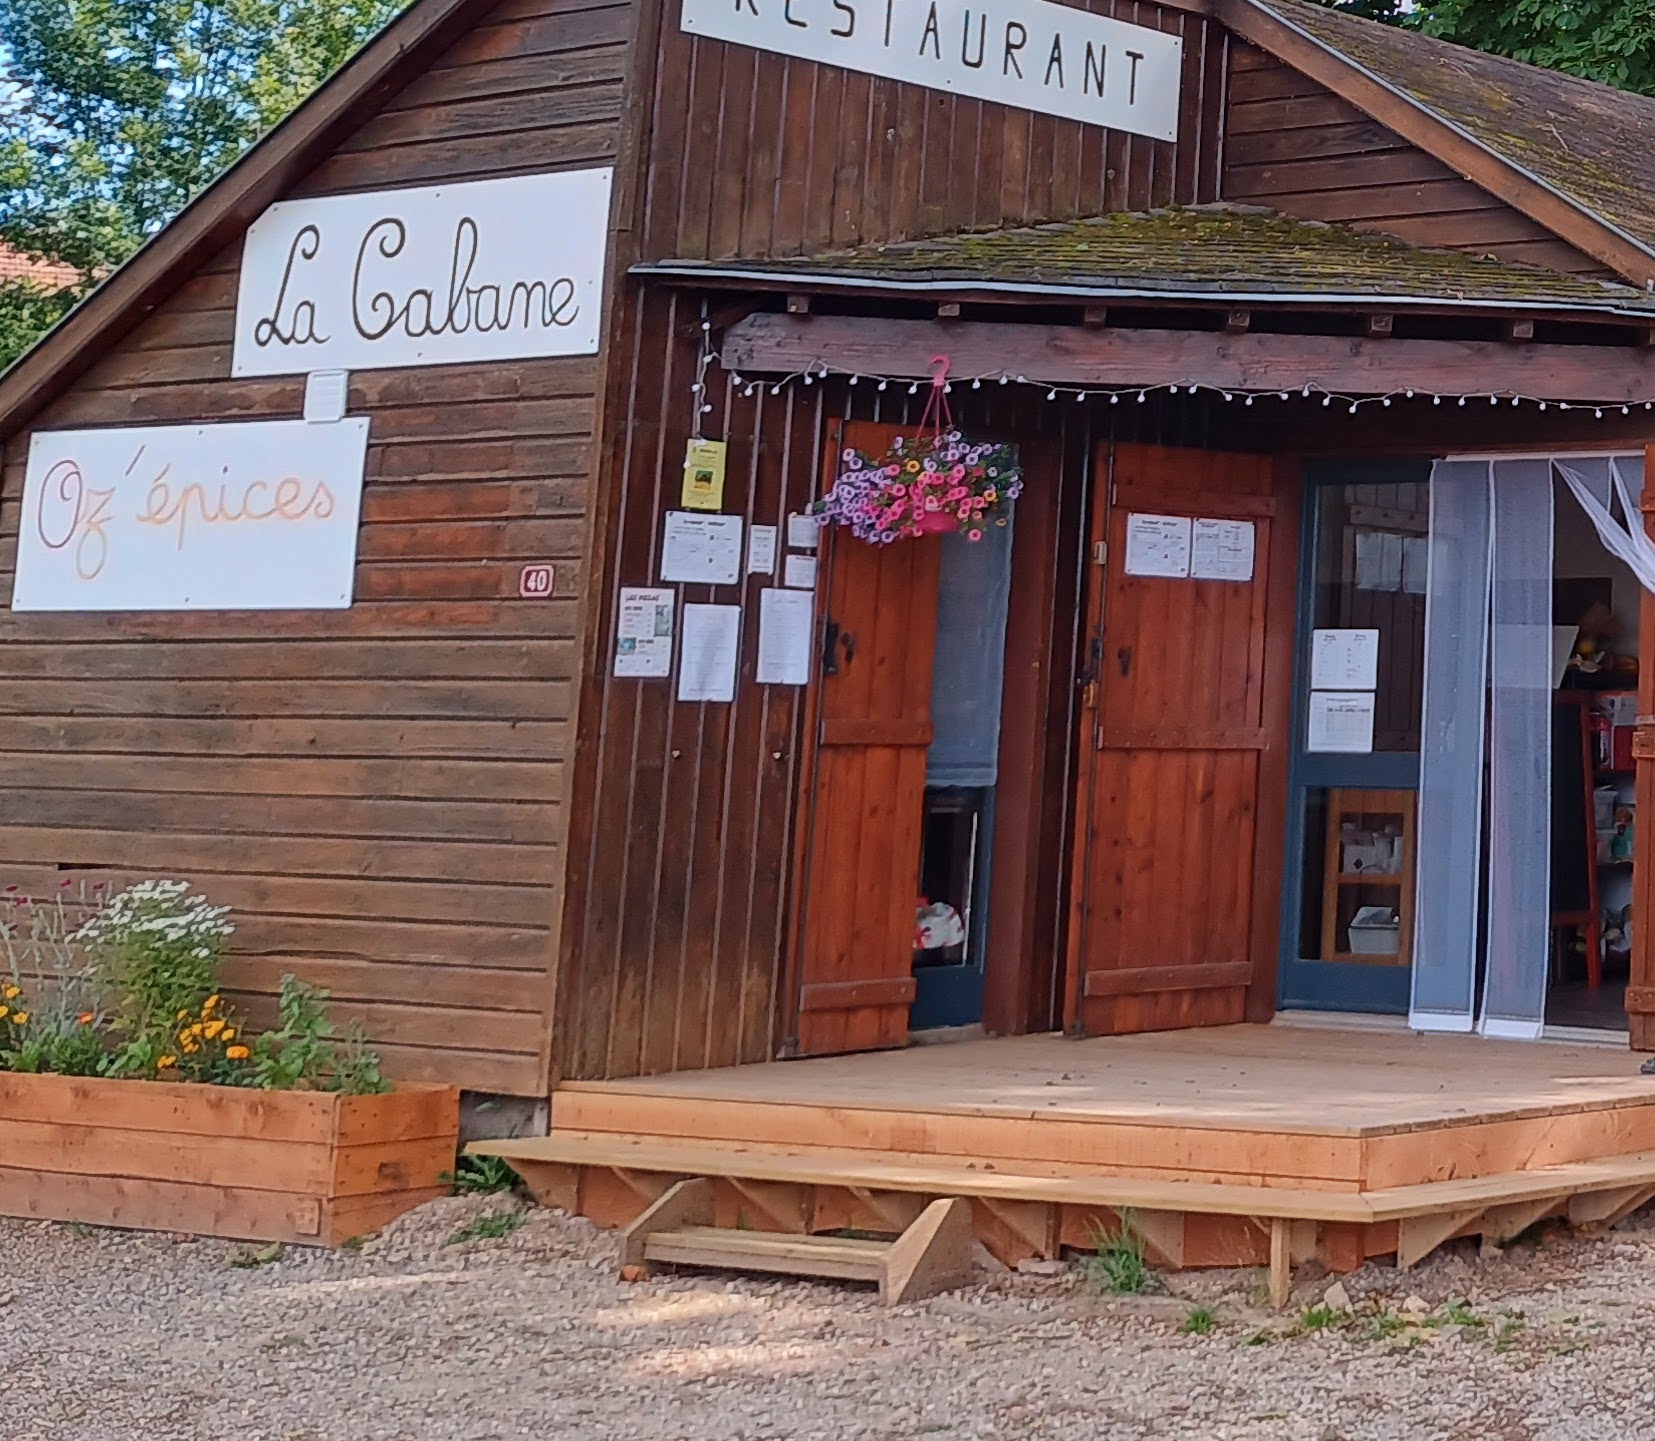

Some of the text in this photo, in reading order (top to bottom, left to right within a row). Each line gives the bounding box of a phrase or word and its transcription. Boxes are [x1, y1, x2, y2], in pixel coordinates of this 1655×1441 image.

[254, 216, 580, 347] La Cabane
[526, 570, 547, 591] 40
